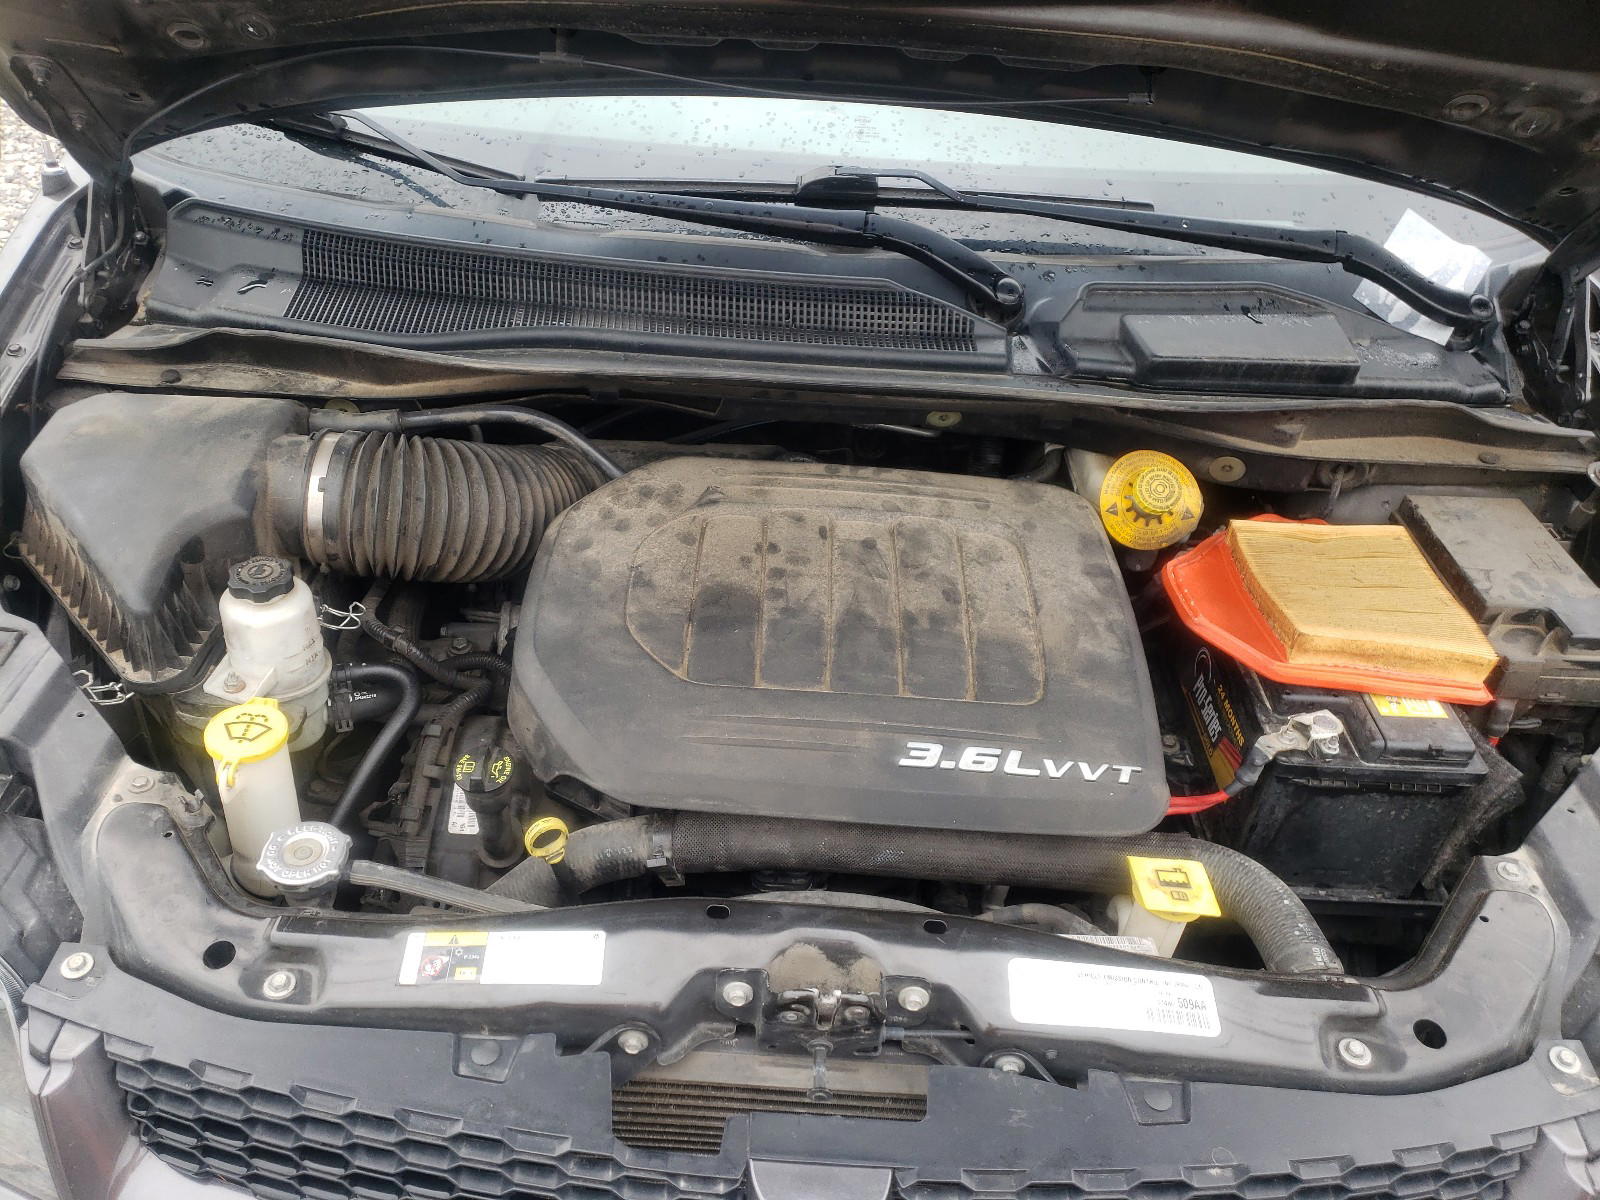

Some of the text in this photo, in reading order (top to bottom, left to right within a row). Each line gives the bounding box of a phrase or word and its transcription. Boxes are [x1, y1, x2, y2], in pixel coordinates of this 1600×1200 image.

[1192, 673, 1222, 743] Pro-Series
[1223, 699, 1245, 748] MONTHS
[1176, 997, 1208, 1011] 509AA
